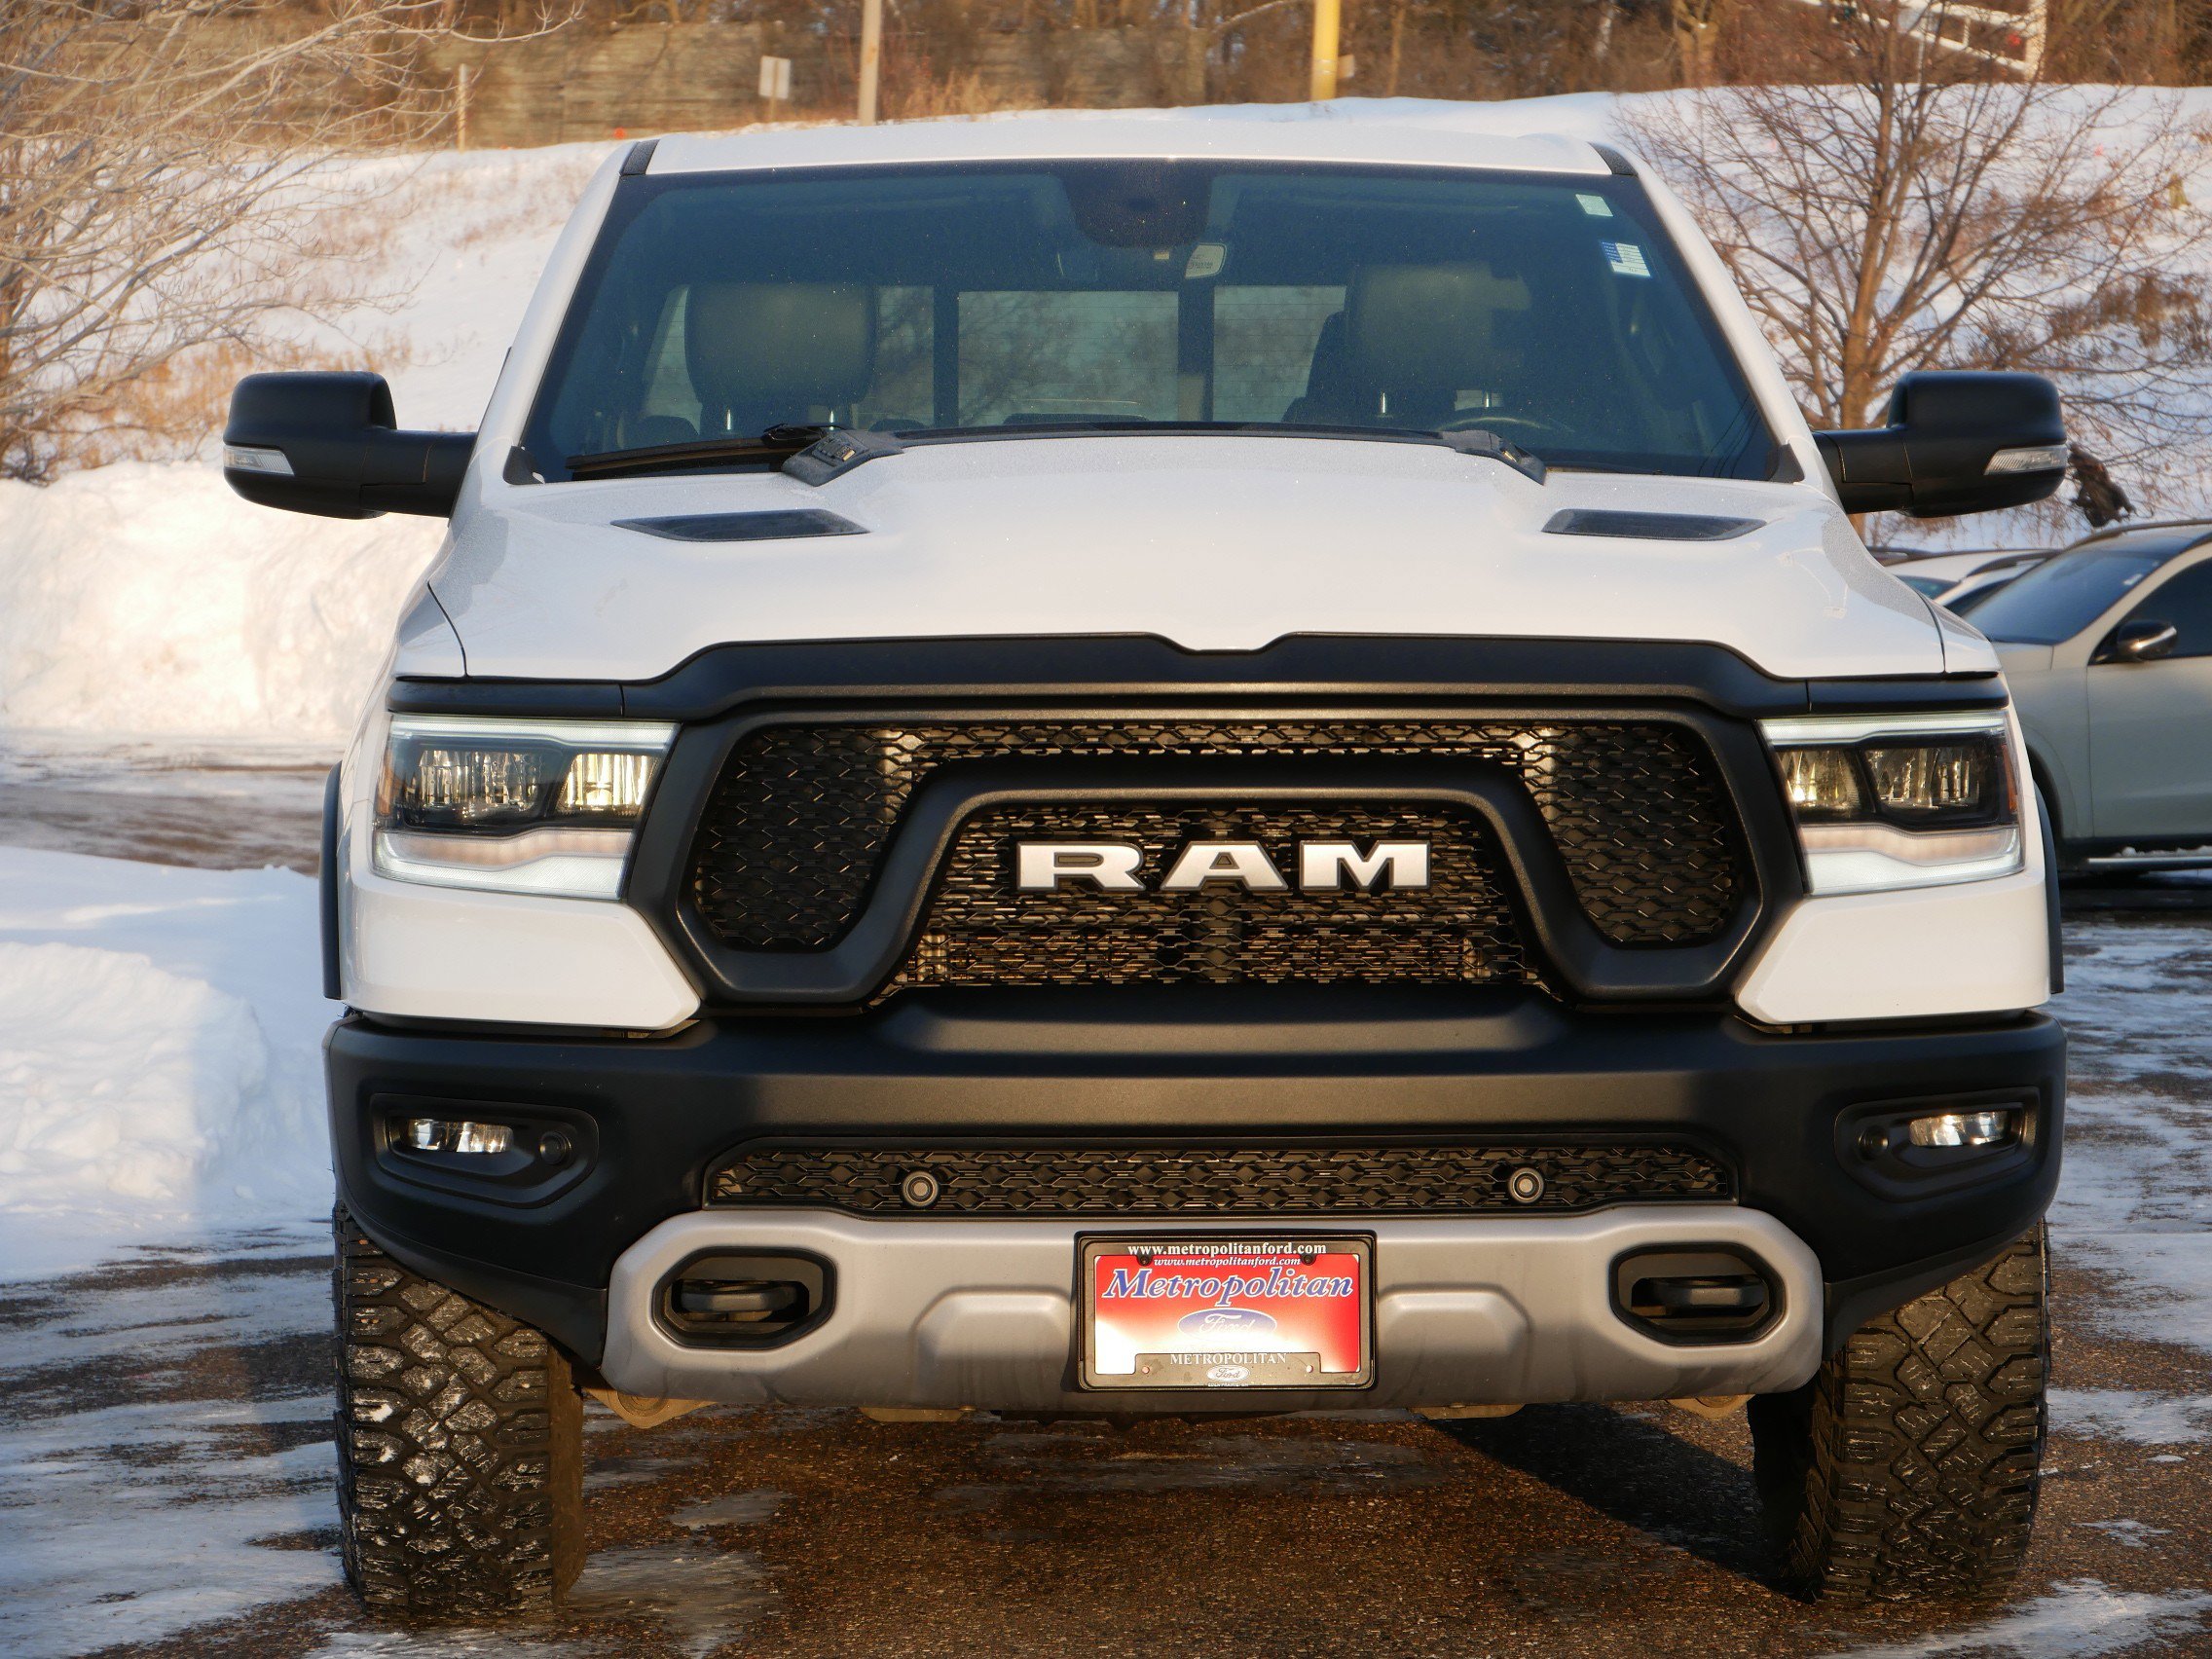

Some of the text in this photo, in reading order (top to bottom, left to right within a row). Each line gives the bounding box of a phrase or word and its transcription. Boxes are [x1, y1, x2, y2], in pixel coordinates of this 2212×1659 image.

[1016, 840, 1431, 891] RAM
[1127, 1242, 1327, 1257] www.metropolitanford.com
[1153, 1256, 1301, 1268] www.metropolitanford.com
[1102, 1266, 1354, 1307] Metropolitan
[1198, 1312, 1256, 1333] Ford
[1169, 1352, 1287, 1365] METROPOLITAN
[1215, 1367, 1241, 1379] Ford
